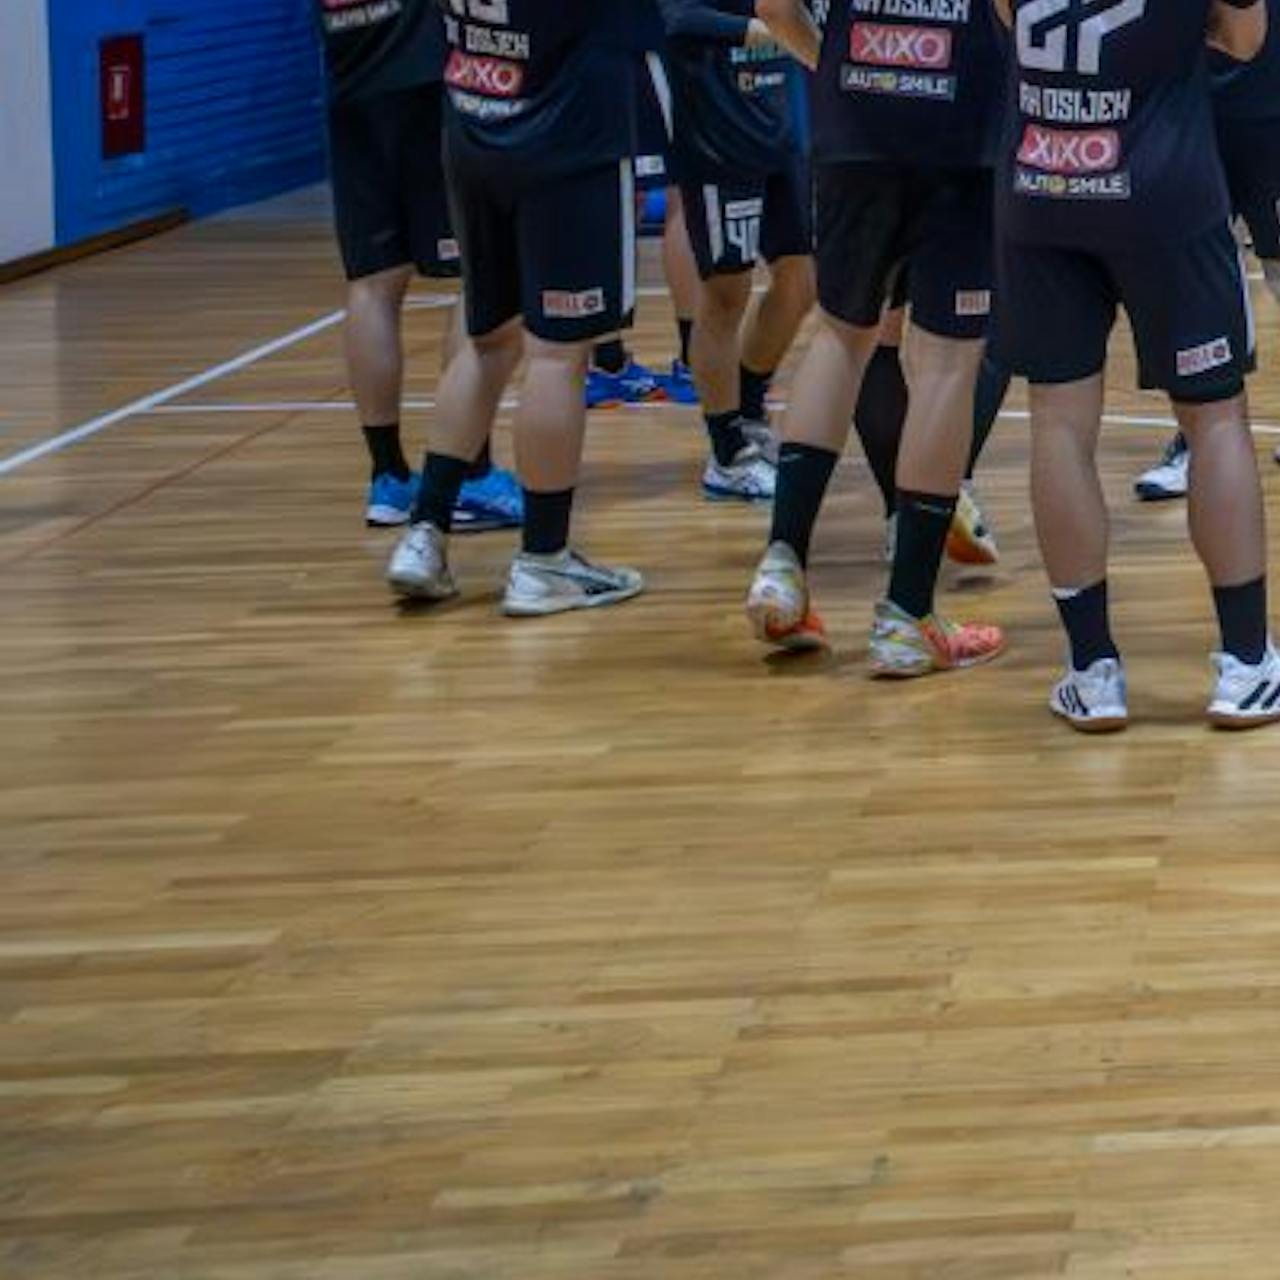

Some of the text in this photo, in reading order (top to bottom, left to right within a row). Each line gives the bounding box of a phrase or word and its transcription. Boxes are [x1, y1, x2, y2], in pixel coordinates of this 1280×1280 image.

[860, 30, 946, 63] XIXO
[1043, 87, 1131, 122] OSIJEK
[1029, 131, 1112, 168] XIXO
